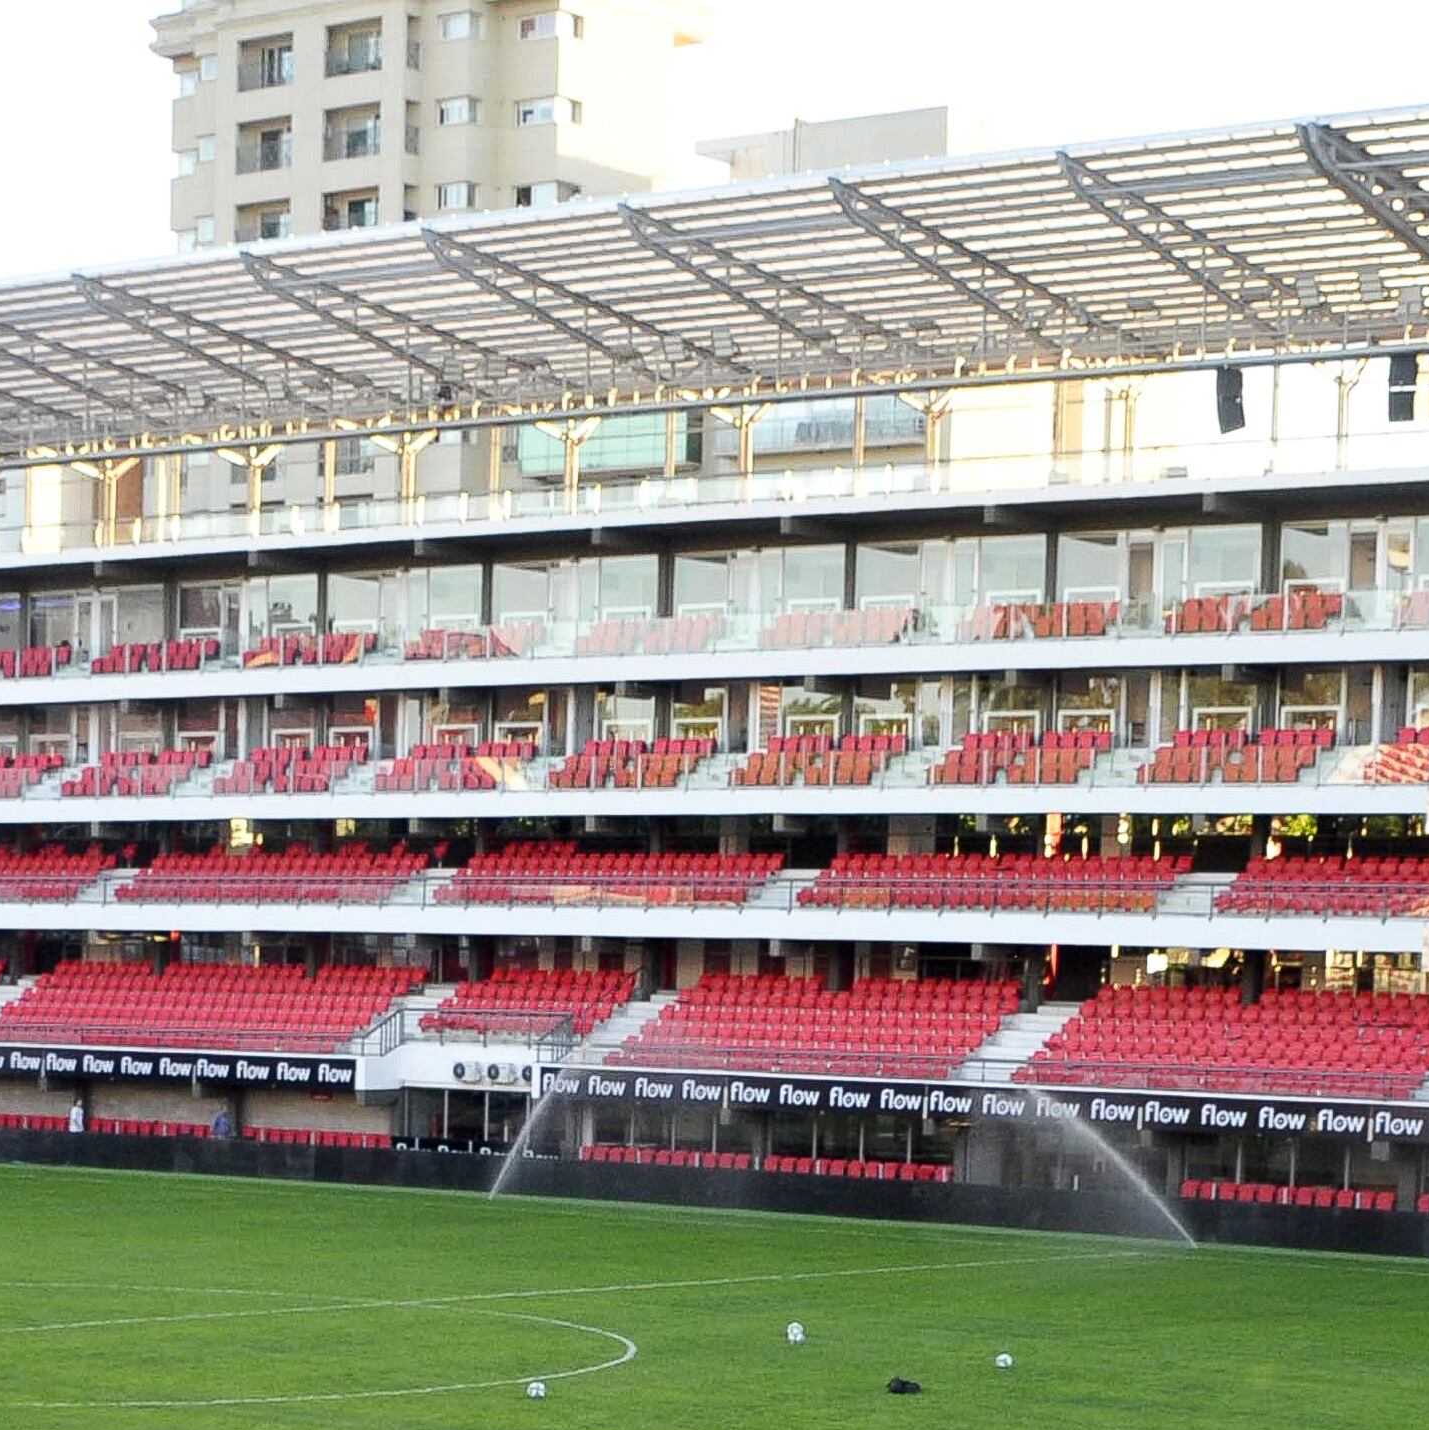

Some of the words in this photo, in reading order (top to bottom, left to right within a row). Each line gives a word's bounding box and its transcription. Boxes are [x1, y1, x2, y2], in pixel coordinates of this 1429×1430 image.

[10, 1052, 40, 1070] flow
[46, 1053, 76, 1071] flow
[83, 1055, 114, 1073] flow
[121, 1057, 152, 1075] flow
[159, 1058, 192, 1076] flow
[197, 1058, 229, 1078] flow
[237, 1060, 270, 1080] flow
[277, 1062, 310, 1082] flow
[318, 1064, 352, 1083] flow
[543, 1073, 579, 1094] flow
[588, 1075, 625, 1097] flow
[635, 1077, 673, 1099] flow
[682, 1080, 721, 1101] flow
[731, 1082, 770, 1103] flow
[780, 1084, 820, 1106] flow
[829, 1087, 870, 1109] flow
[880, 1089, 921, 1111] flow
[930, 1091, 972, 1114] flow
[982, 1094, 1025, 1117] flow
[1036, 1096, 1080, 1119] flow
[1090, 1099, 1135, 1121] flow
[1144, 1101, 1190, 1125] flow
[1201, 1104, 1247, 1128] flow
[1258, 1107, 1306, 1130] flow
[1317, 1109, 1365, 1133] flow
[1375, 1112, 1423, 1137] flow
